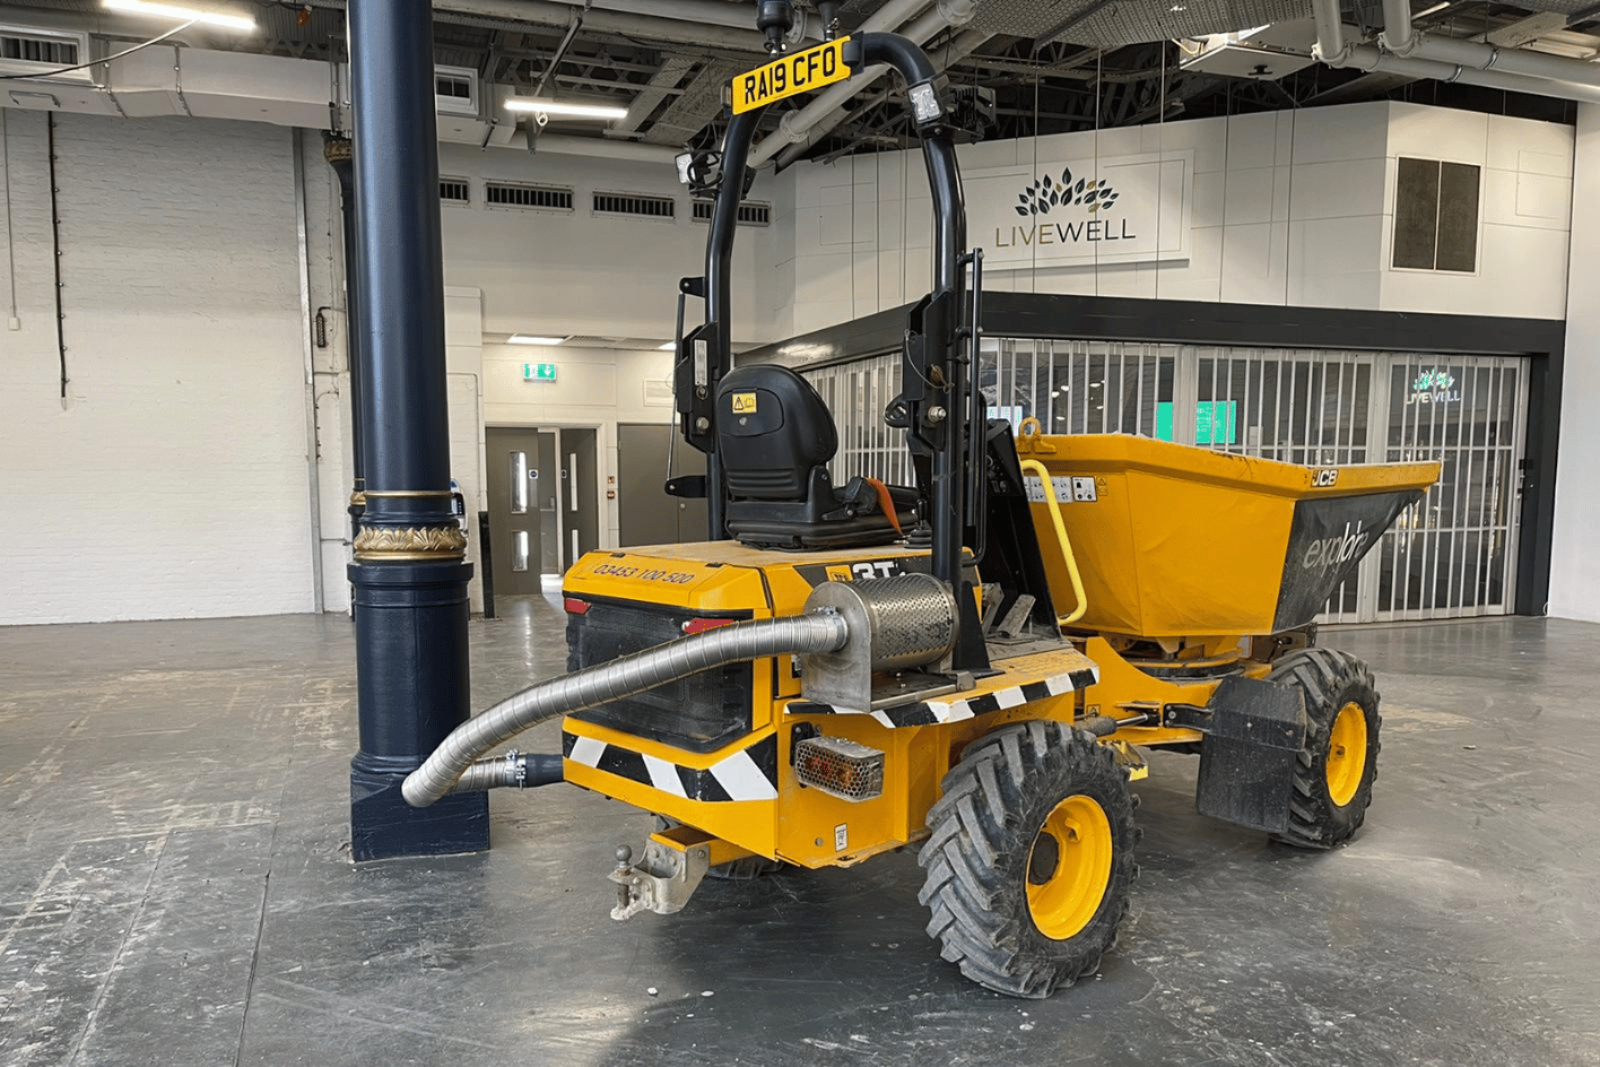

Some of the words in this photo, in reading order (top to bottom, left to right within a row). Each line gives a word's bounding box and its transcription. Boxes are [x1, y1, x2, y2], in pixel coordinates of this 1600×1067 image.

[745, 68, 786, 105] RA19
[792, 46, 836, 89] CFO
[995, 218, 1136, 247] LIVEWELL
[1311, 469, 1338, 487] JCB
[636, 568, 667, 581] 100
[662, 572, 695, 584] 500
